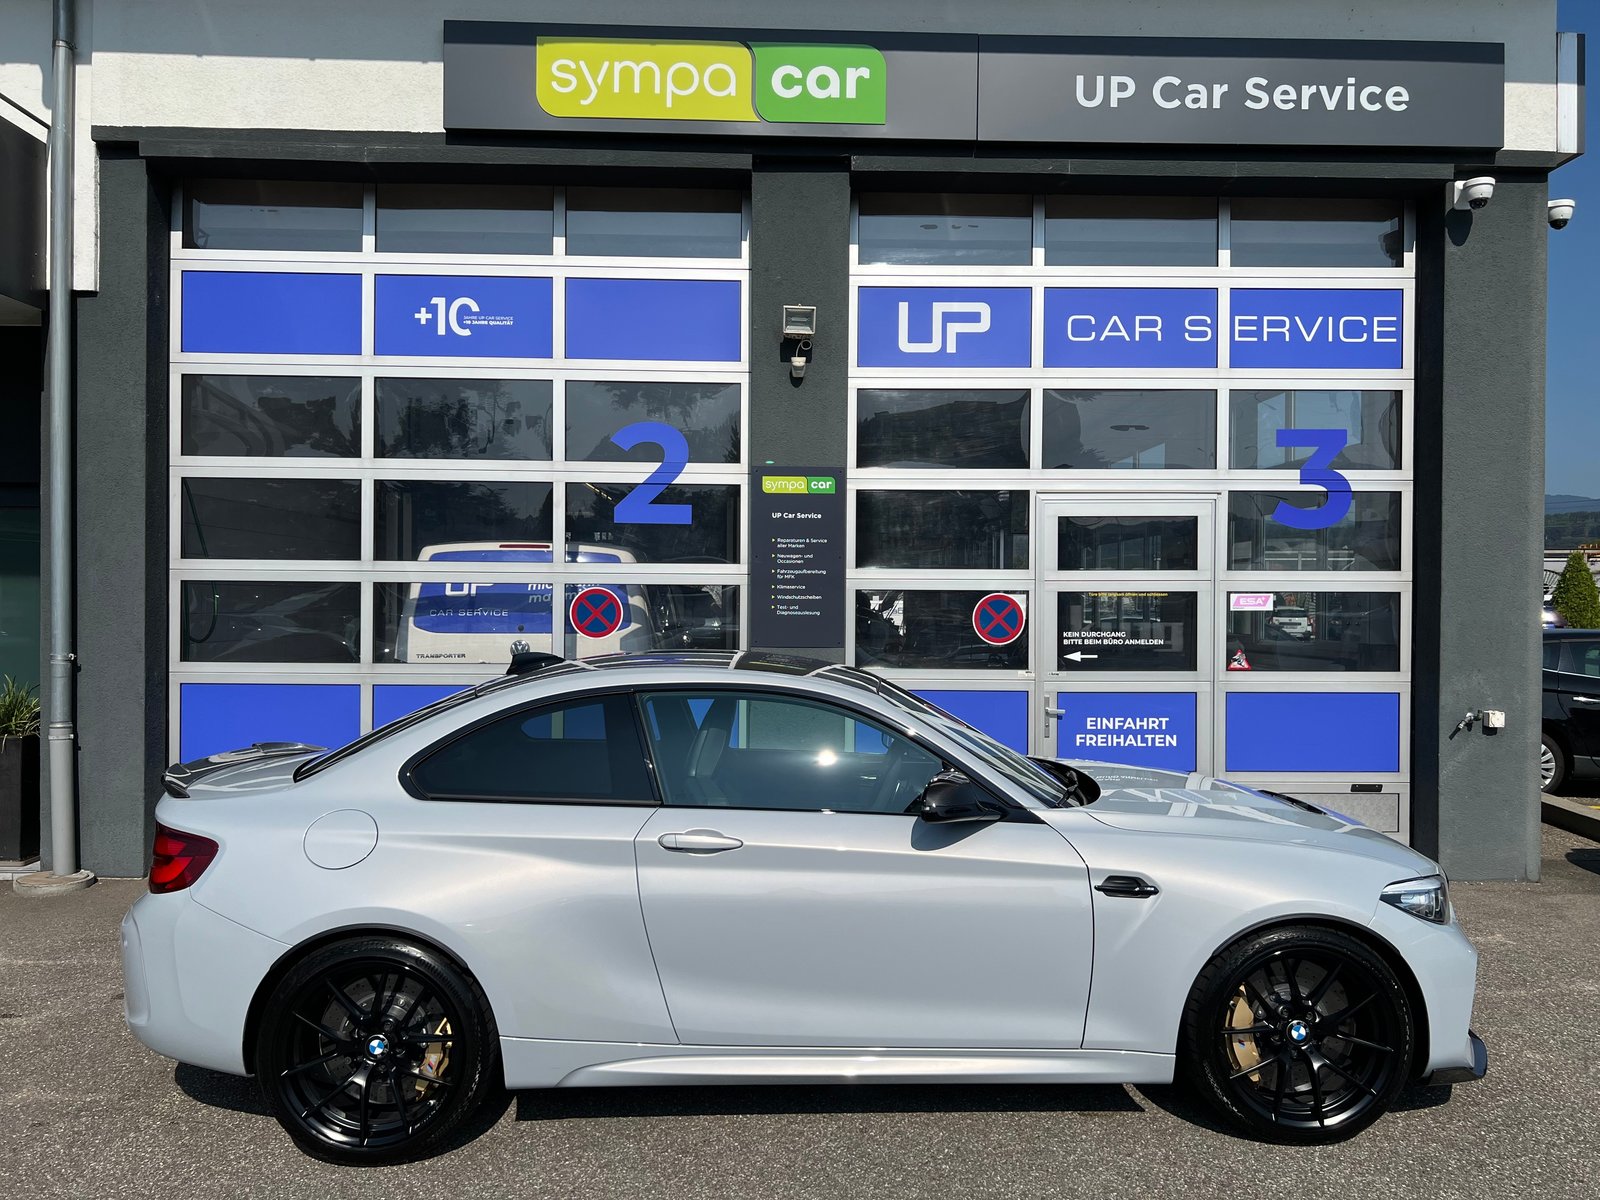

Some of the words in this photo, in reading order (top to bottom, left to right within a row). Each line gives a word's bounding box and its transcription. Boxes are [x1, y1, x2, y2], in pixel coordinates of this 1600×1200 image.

[551, 57, 737, 108] sympa
[771, 63, 871, 100] car
[1075, 74, 1136, 109] UP
[1153, 76, 1228, 110] Car
[1244, 76, 1410, 112] Service
[898, 301, 991, 353] UP
[1066, 314, 1163, 342] CAR
[610, 422, 693, 525] 2
[765, 479, 805, 492] sympa
[811, 481, 832, 489] car
[1271, 429, 1353, 530] 3
[458, 608, 509, 617] SERVICE
[1075, 734, 1177, 747] FREIHALTEN
[1086, 717, 1169, 730] EINFAHRT
